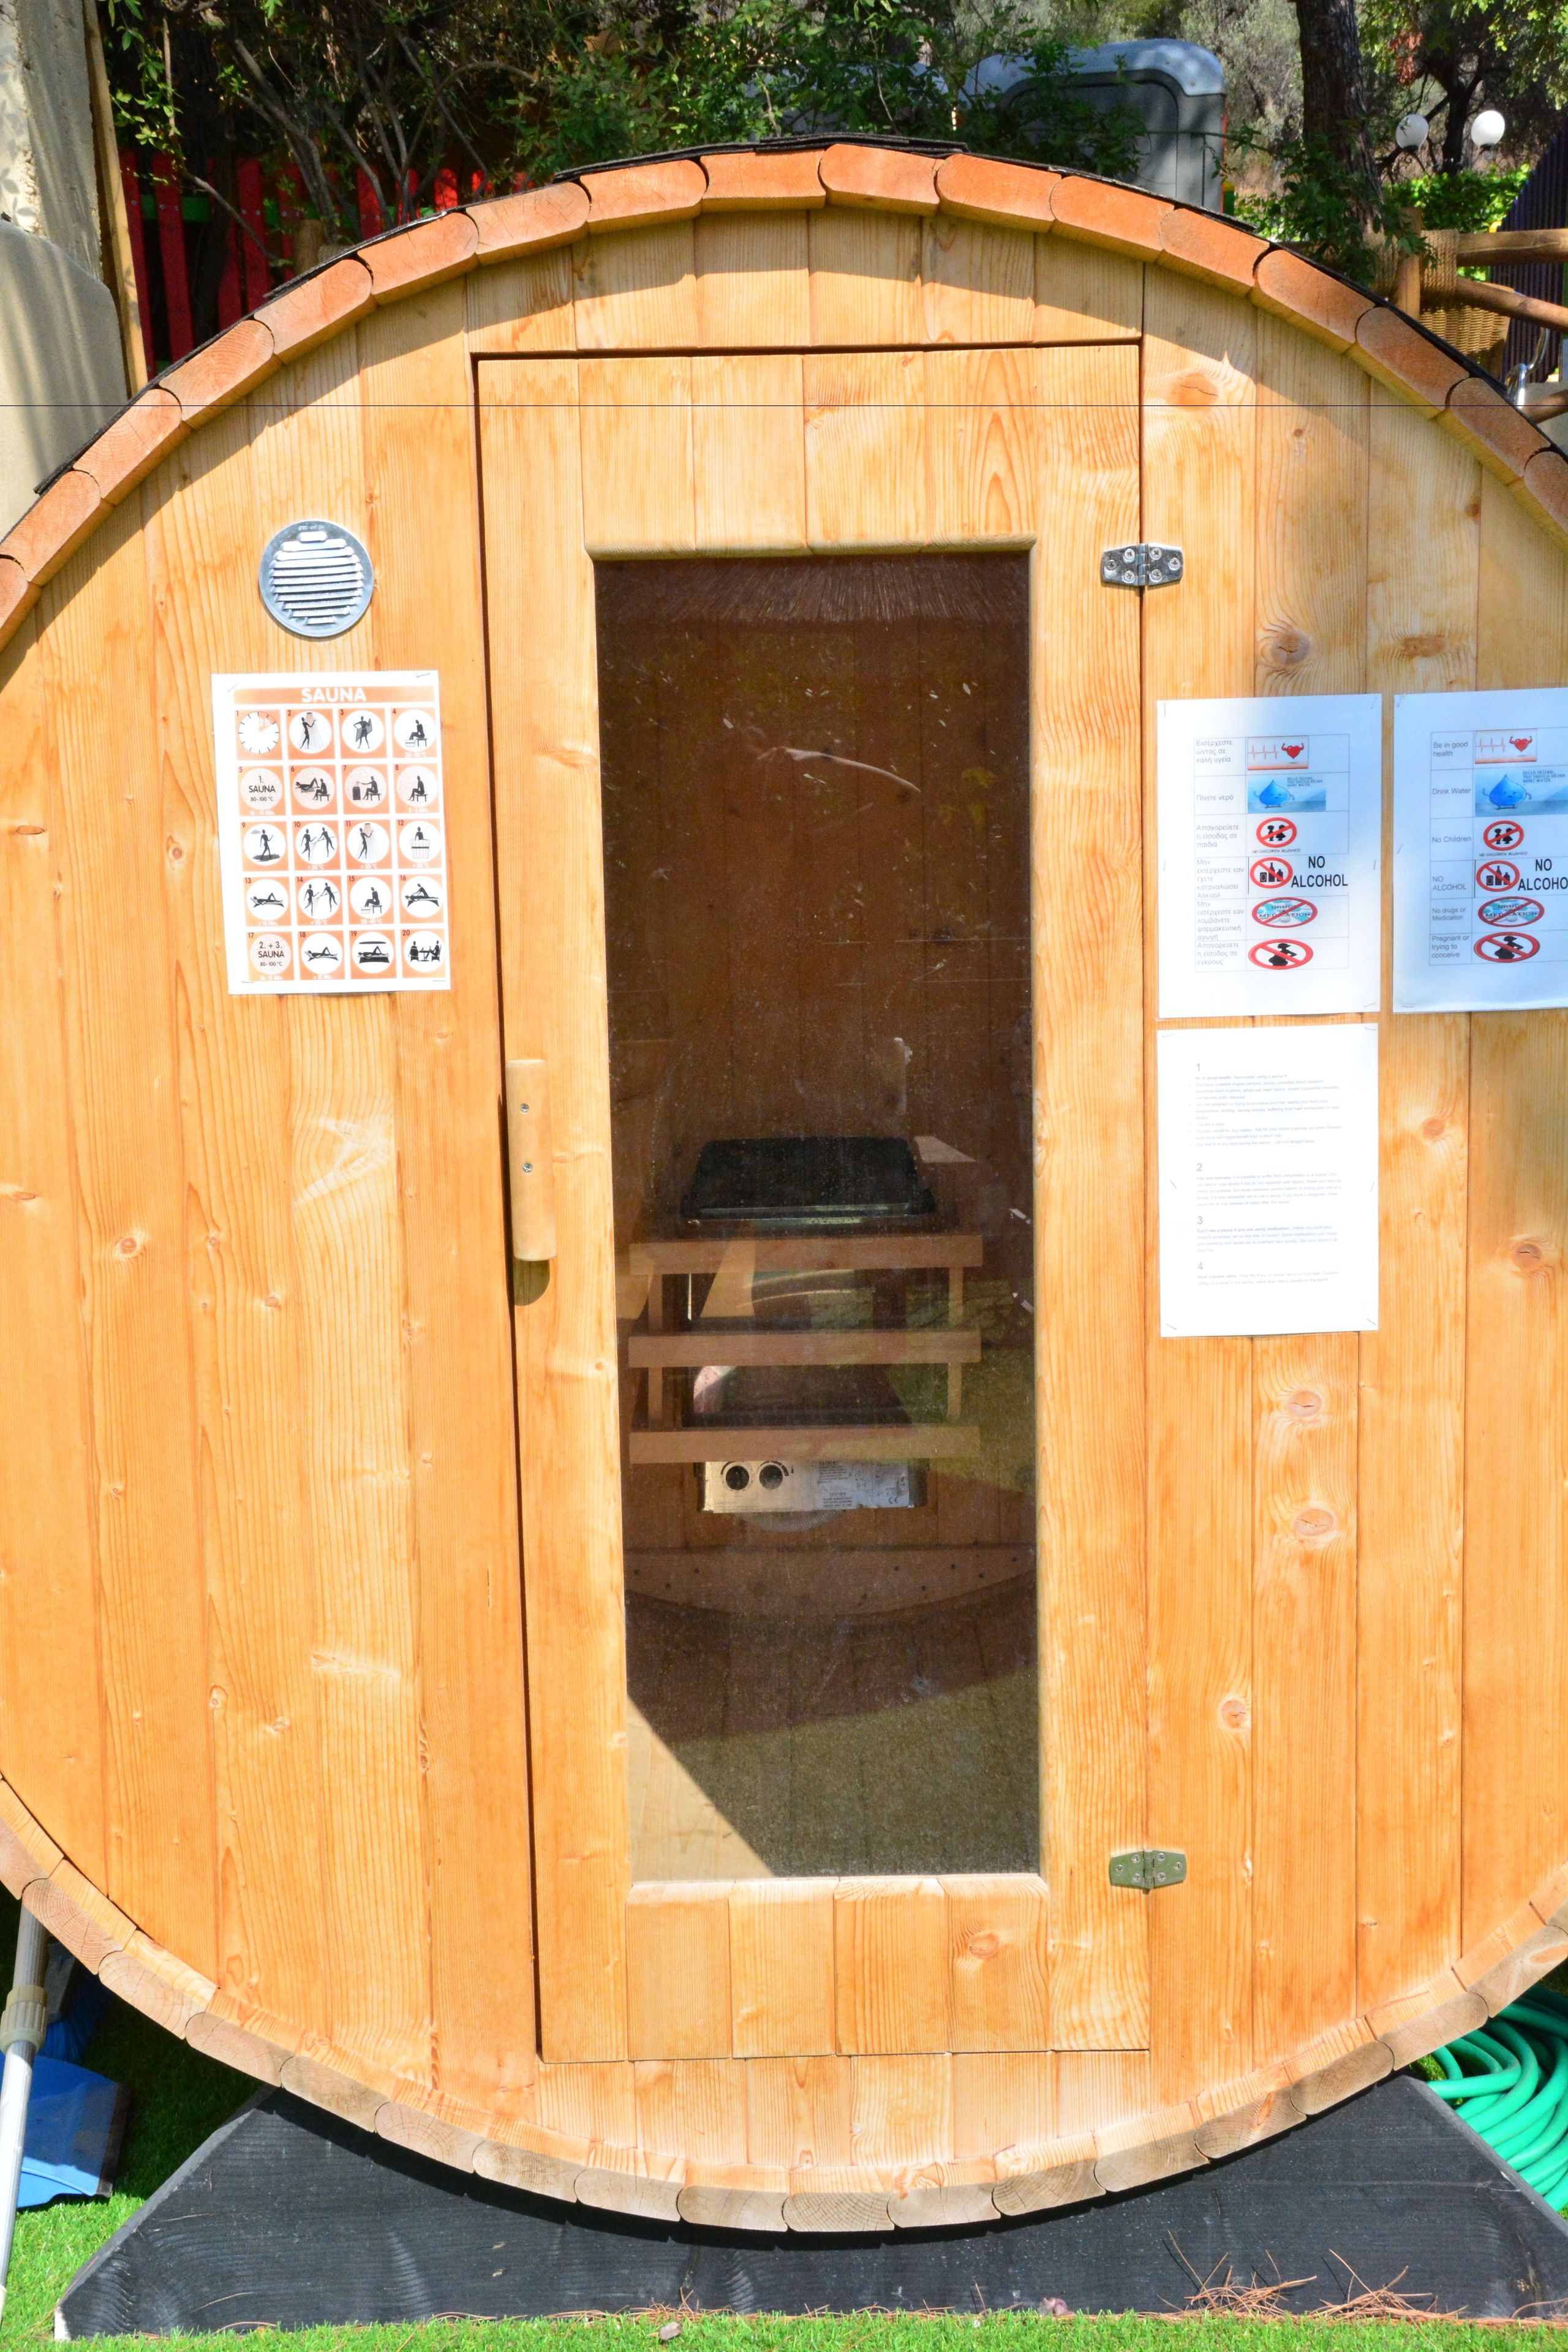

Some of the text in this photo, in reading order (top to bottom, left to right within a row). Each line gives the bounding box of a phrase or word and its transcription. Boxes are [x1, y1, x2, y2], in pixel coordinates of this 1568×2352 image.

[301, 687, 367, 703] SAUNA
[1308, 856, 1325, 869] NO
[1536, 858, 1552, 871] NO
[1291, 874, 1348, 888] ALCOHOL
[1196, 1063, 1200, 1071] 1
[1196, 1216, 1204, 1224] 3
[1197, 1262, 1204, 1270] 4
